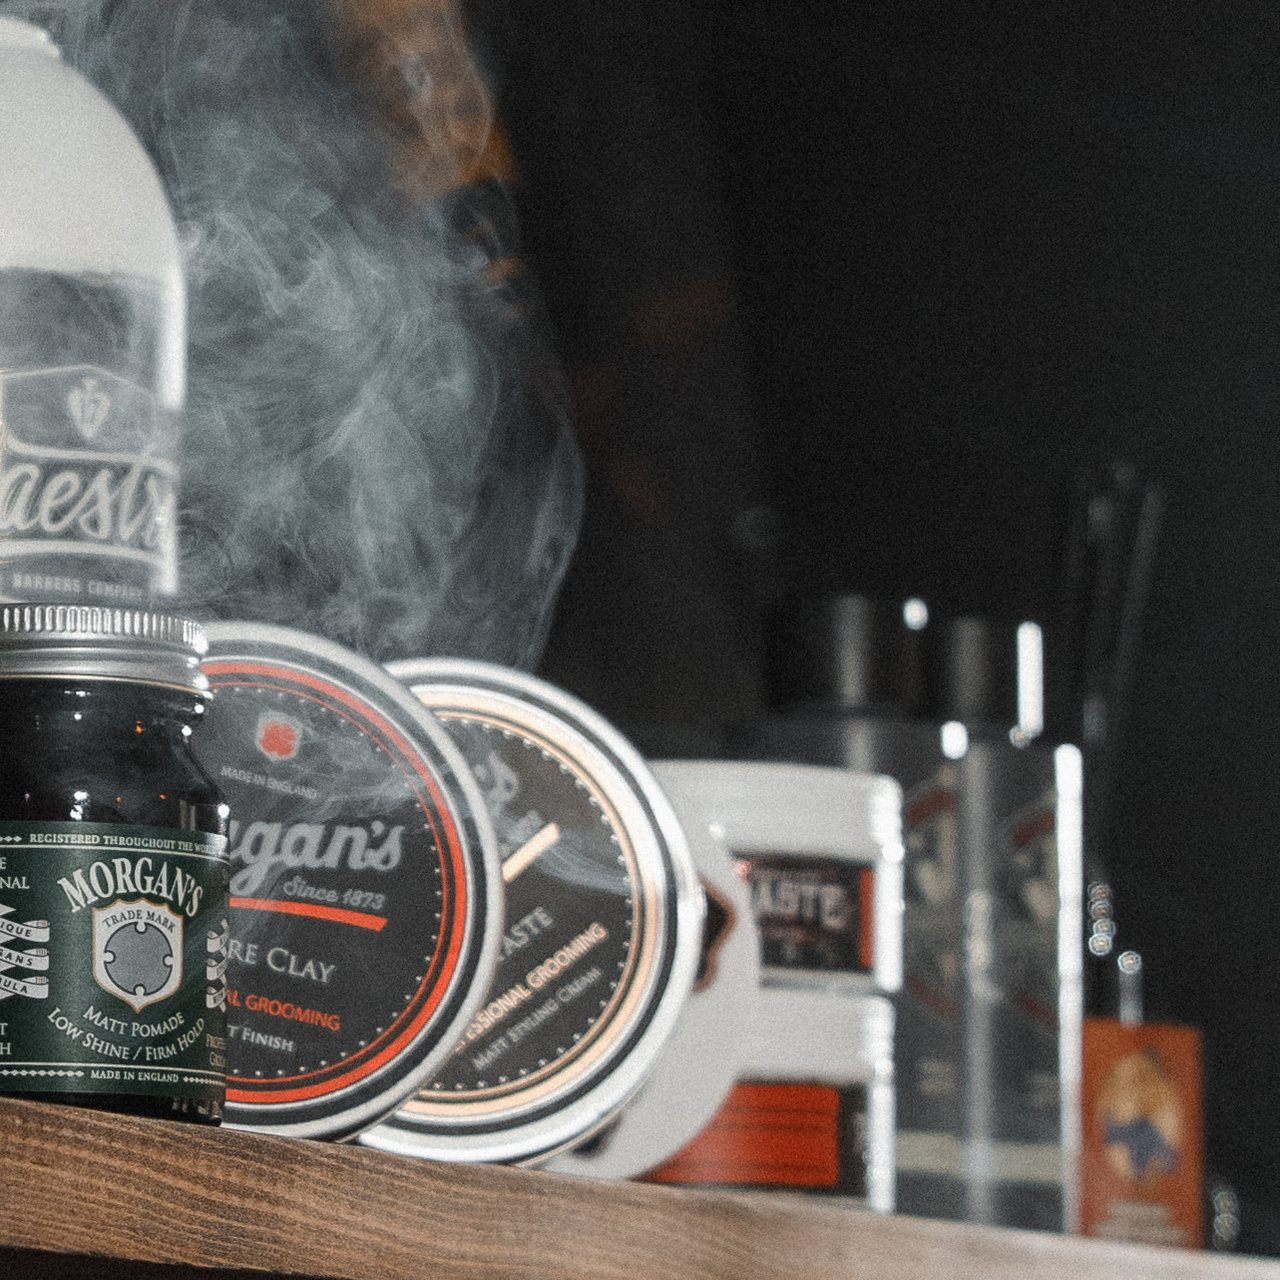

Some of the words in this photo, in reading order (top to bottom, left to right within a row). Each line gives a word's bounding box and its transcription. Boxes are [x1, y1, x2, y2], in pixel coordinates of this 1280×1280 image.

[220, 765, 252, 783] MADE
[253, 773, 267, 787] IN
[268, 776, 318, 800] ENGLAND
[29, 833, 100, 844] REGISTERED
[103, 835, 175, 850] THROUGHOUT
[177, 840, 193, 851] THE
[57, 856, 204, 917] MORGAN'S
[282, 875, 338, 902] Since
[342, 887, 386, 910] 1873
[102, 909, 143, 928] TRADE
[146, 910, 176, 933] MARK
[499, 906, 555, 960] ASTE
[227, 938, 259, 965] RE
[266, 946, 337, 983] CLAY
[525, 921, 609, 989] GROOMING
[83, 1005, 128, 1035] MATT
[131, 1011, 185, 1038] POMADE
[244, 994, 341, 1032] GROOMING
[47, 1006, 84, 1040] LOW
[82, 1032, 130, 1060] SHINE
[132, 1046, 142, 1061] /
[146, 1045, 178, 1061] FIRM
[177, 1018, 206, 1052] HOLD
[242, 1027, 294, 1053] FINISH
[472, 1036, 510, 1070] MATT
[90, 1070, 120, 1080] MADE
[123, 1071, 135, 1080] IN
[137, 1072, 179, 1083] ENGLAND
